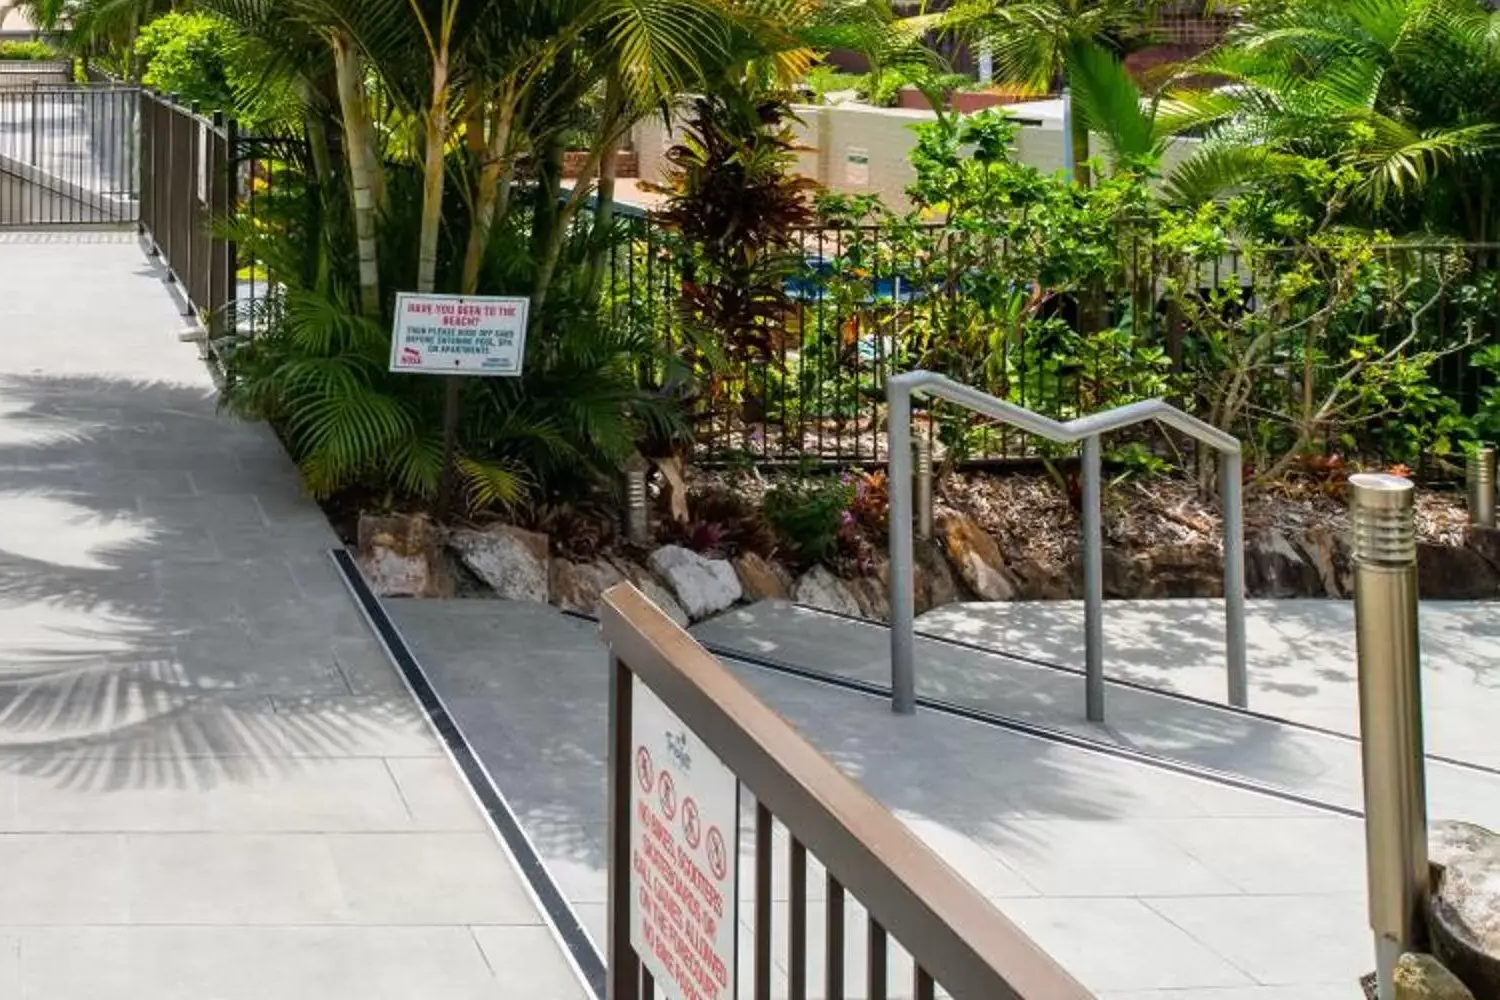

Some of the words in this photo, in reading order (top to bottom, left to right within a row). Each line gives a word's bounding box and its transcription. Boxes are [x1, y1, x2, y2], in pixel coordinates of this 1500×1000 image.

[407, 304, 432, 315] HAVE
[435, 304, 454, 315] YOU
[458, 305, 481, 316] BEEN
[484, 305, 496, 316] TO
[499, 306, 516, 317] THE
[443, 316, 479, 326] BEACH?
